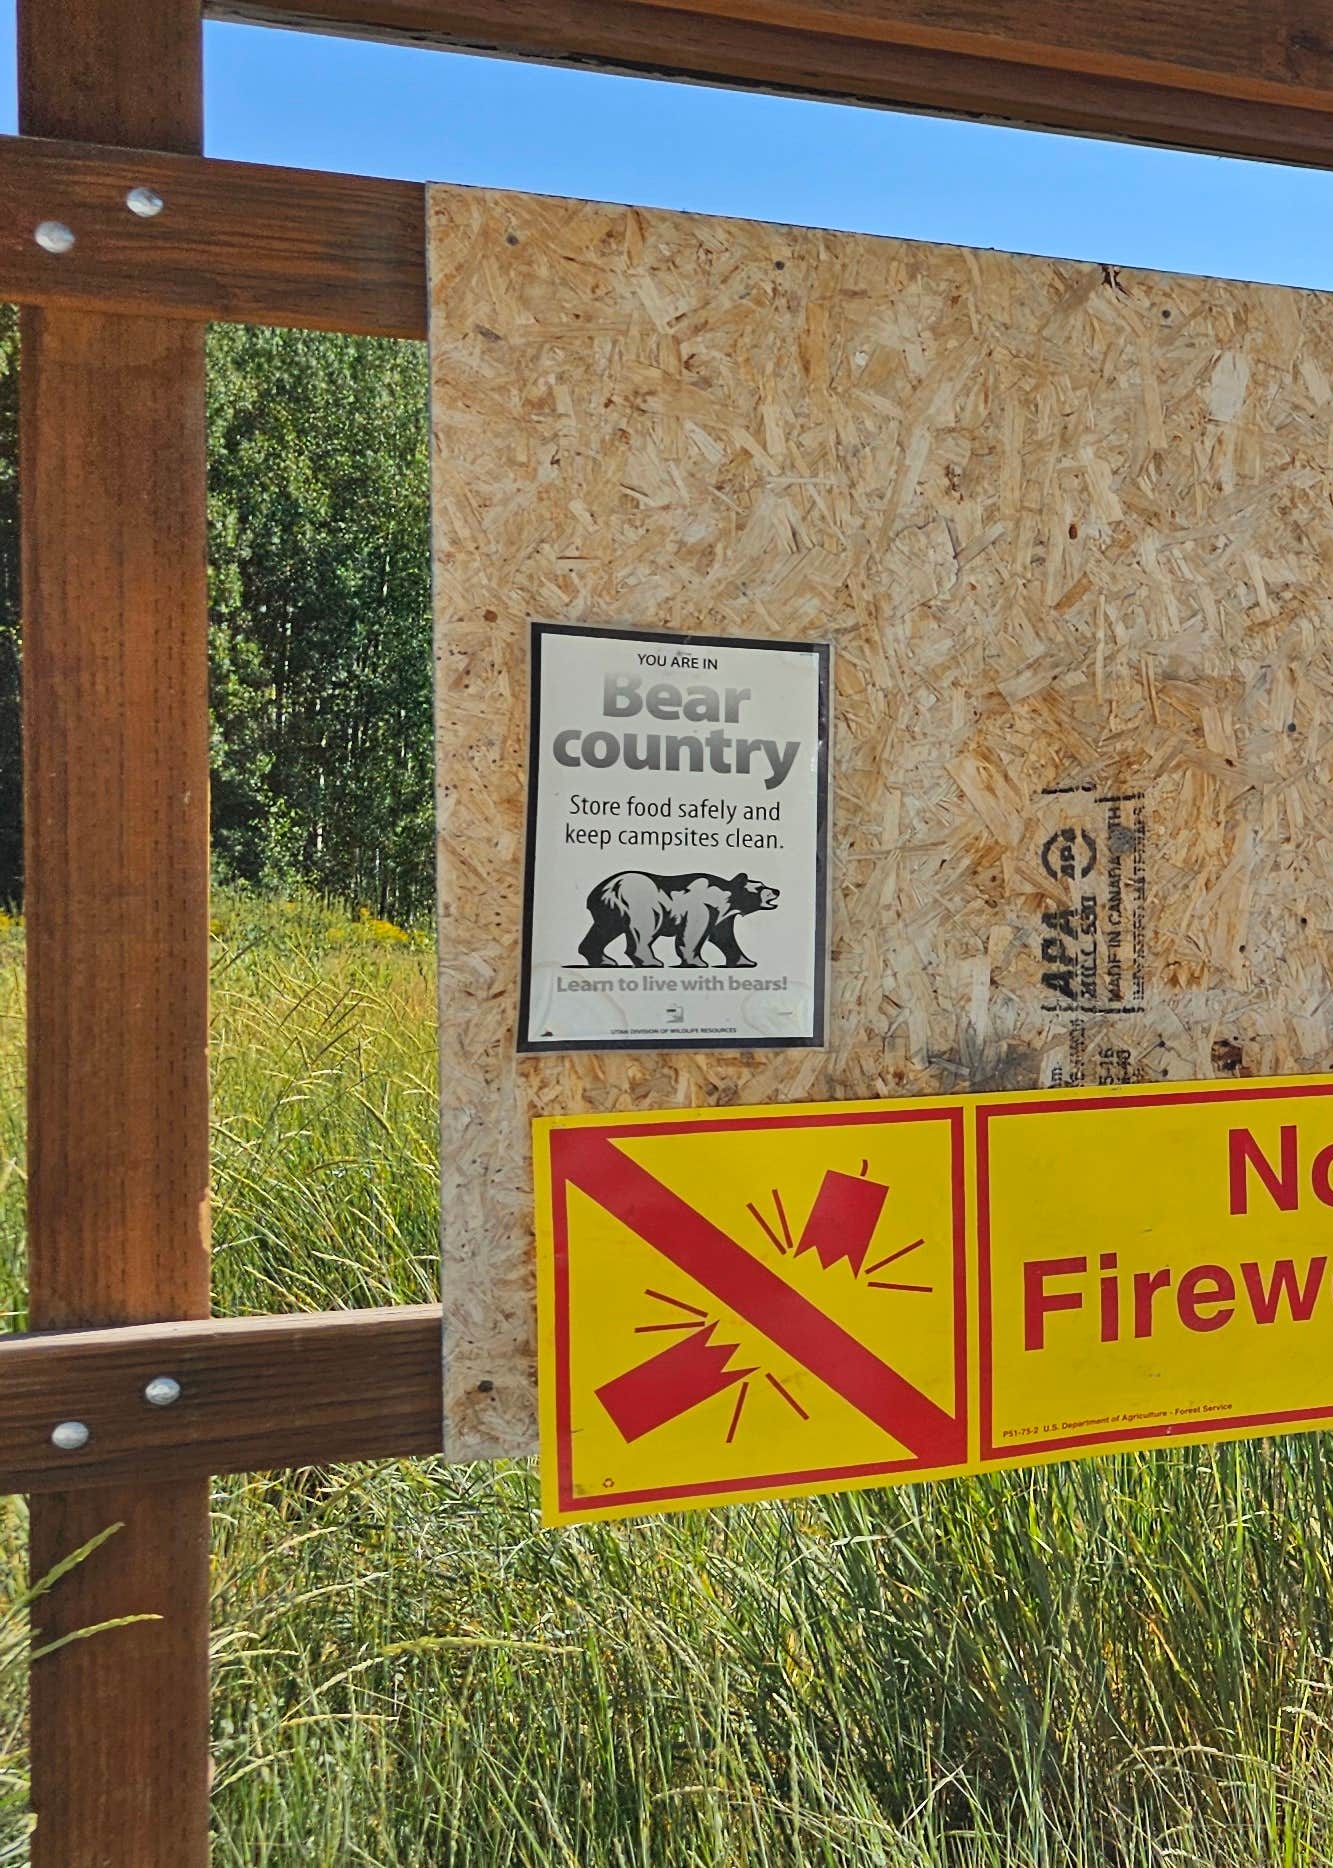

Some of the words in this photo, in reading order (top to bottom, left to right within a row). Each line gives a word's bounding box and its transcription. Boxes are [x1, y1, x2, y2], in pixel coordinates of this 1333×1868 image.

[637, 653, 667, 668] YOU
[670, 656, 699, 669] ARE
[703, 658, 718, 670] IN
[603, 672, 752, 724] Bear
[552, 728, 801, 791] country
[569, 794, 621, 816] Store
[627, 796, 672, 818] food
[678, 799, 737, 824] safely
[743, 801, 781, 821] and
[565, 823, 612, 850] keep
[618, 827, 719, 851] campsites
[725, 829, 784, 849] clean.
[1042, 908, 1077, 1001] APA
[556, 975, 614, 993] Learn
[618, 977, 638, 993] to
[643, 975, 677, 992] live
[682, 975, 724, 992] with
[727, 975, 788, 993] bears!
[1043, 1424, 1059, 1433] U.S.
[1061, 1416, 1110, 1430] Department
[1110, 1415, 1120, 1423] of
[1121, 1410, 1167, 1423] Agriculture
[1174, 1407, 1201, 1416] Forest
[1202, 1403, 1233, 1413] Service
